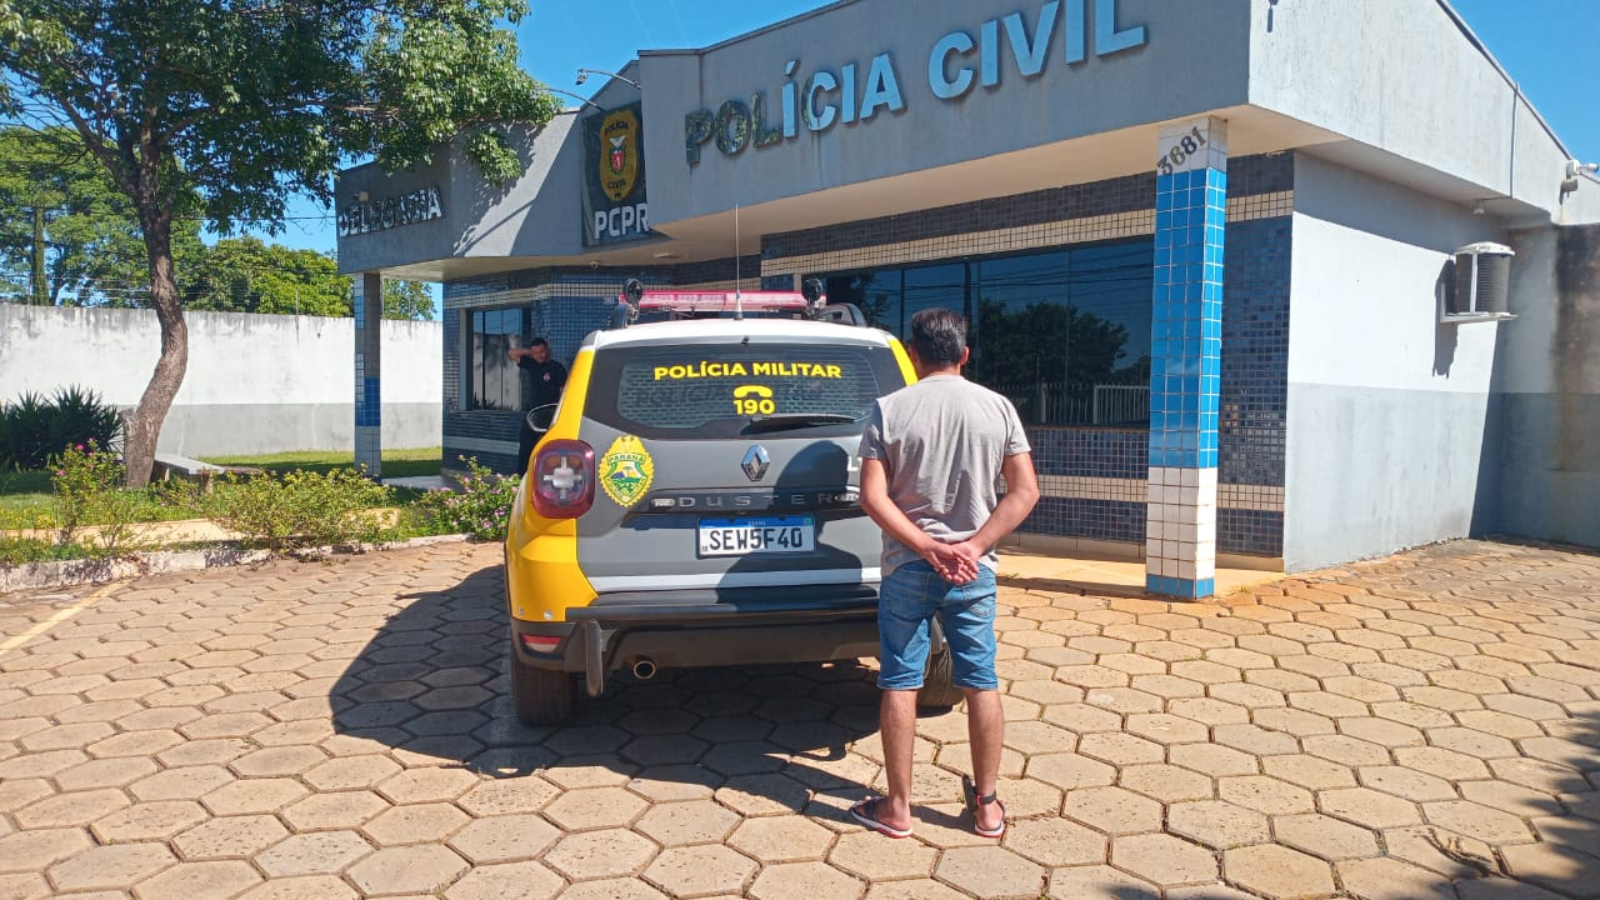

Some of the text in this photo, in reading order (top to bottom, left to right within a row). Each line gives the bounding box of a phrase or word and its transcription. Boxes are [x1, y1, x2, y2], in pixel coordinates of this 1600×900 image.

[685, 0, 1147, 164] POLÍCIA CIVIL
[1157, 126, 1206, 175] 3681
[594, 203, 649, 239] PCPR
[654, 361, 842, 380] POLÍCIA MILITAR
[733, 399, 775, 415] 190
[679, 493, 833, 507] DUSTER
[709, 527, 803, 551] SEW5F40
